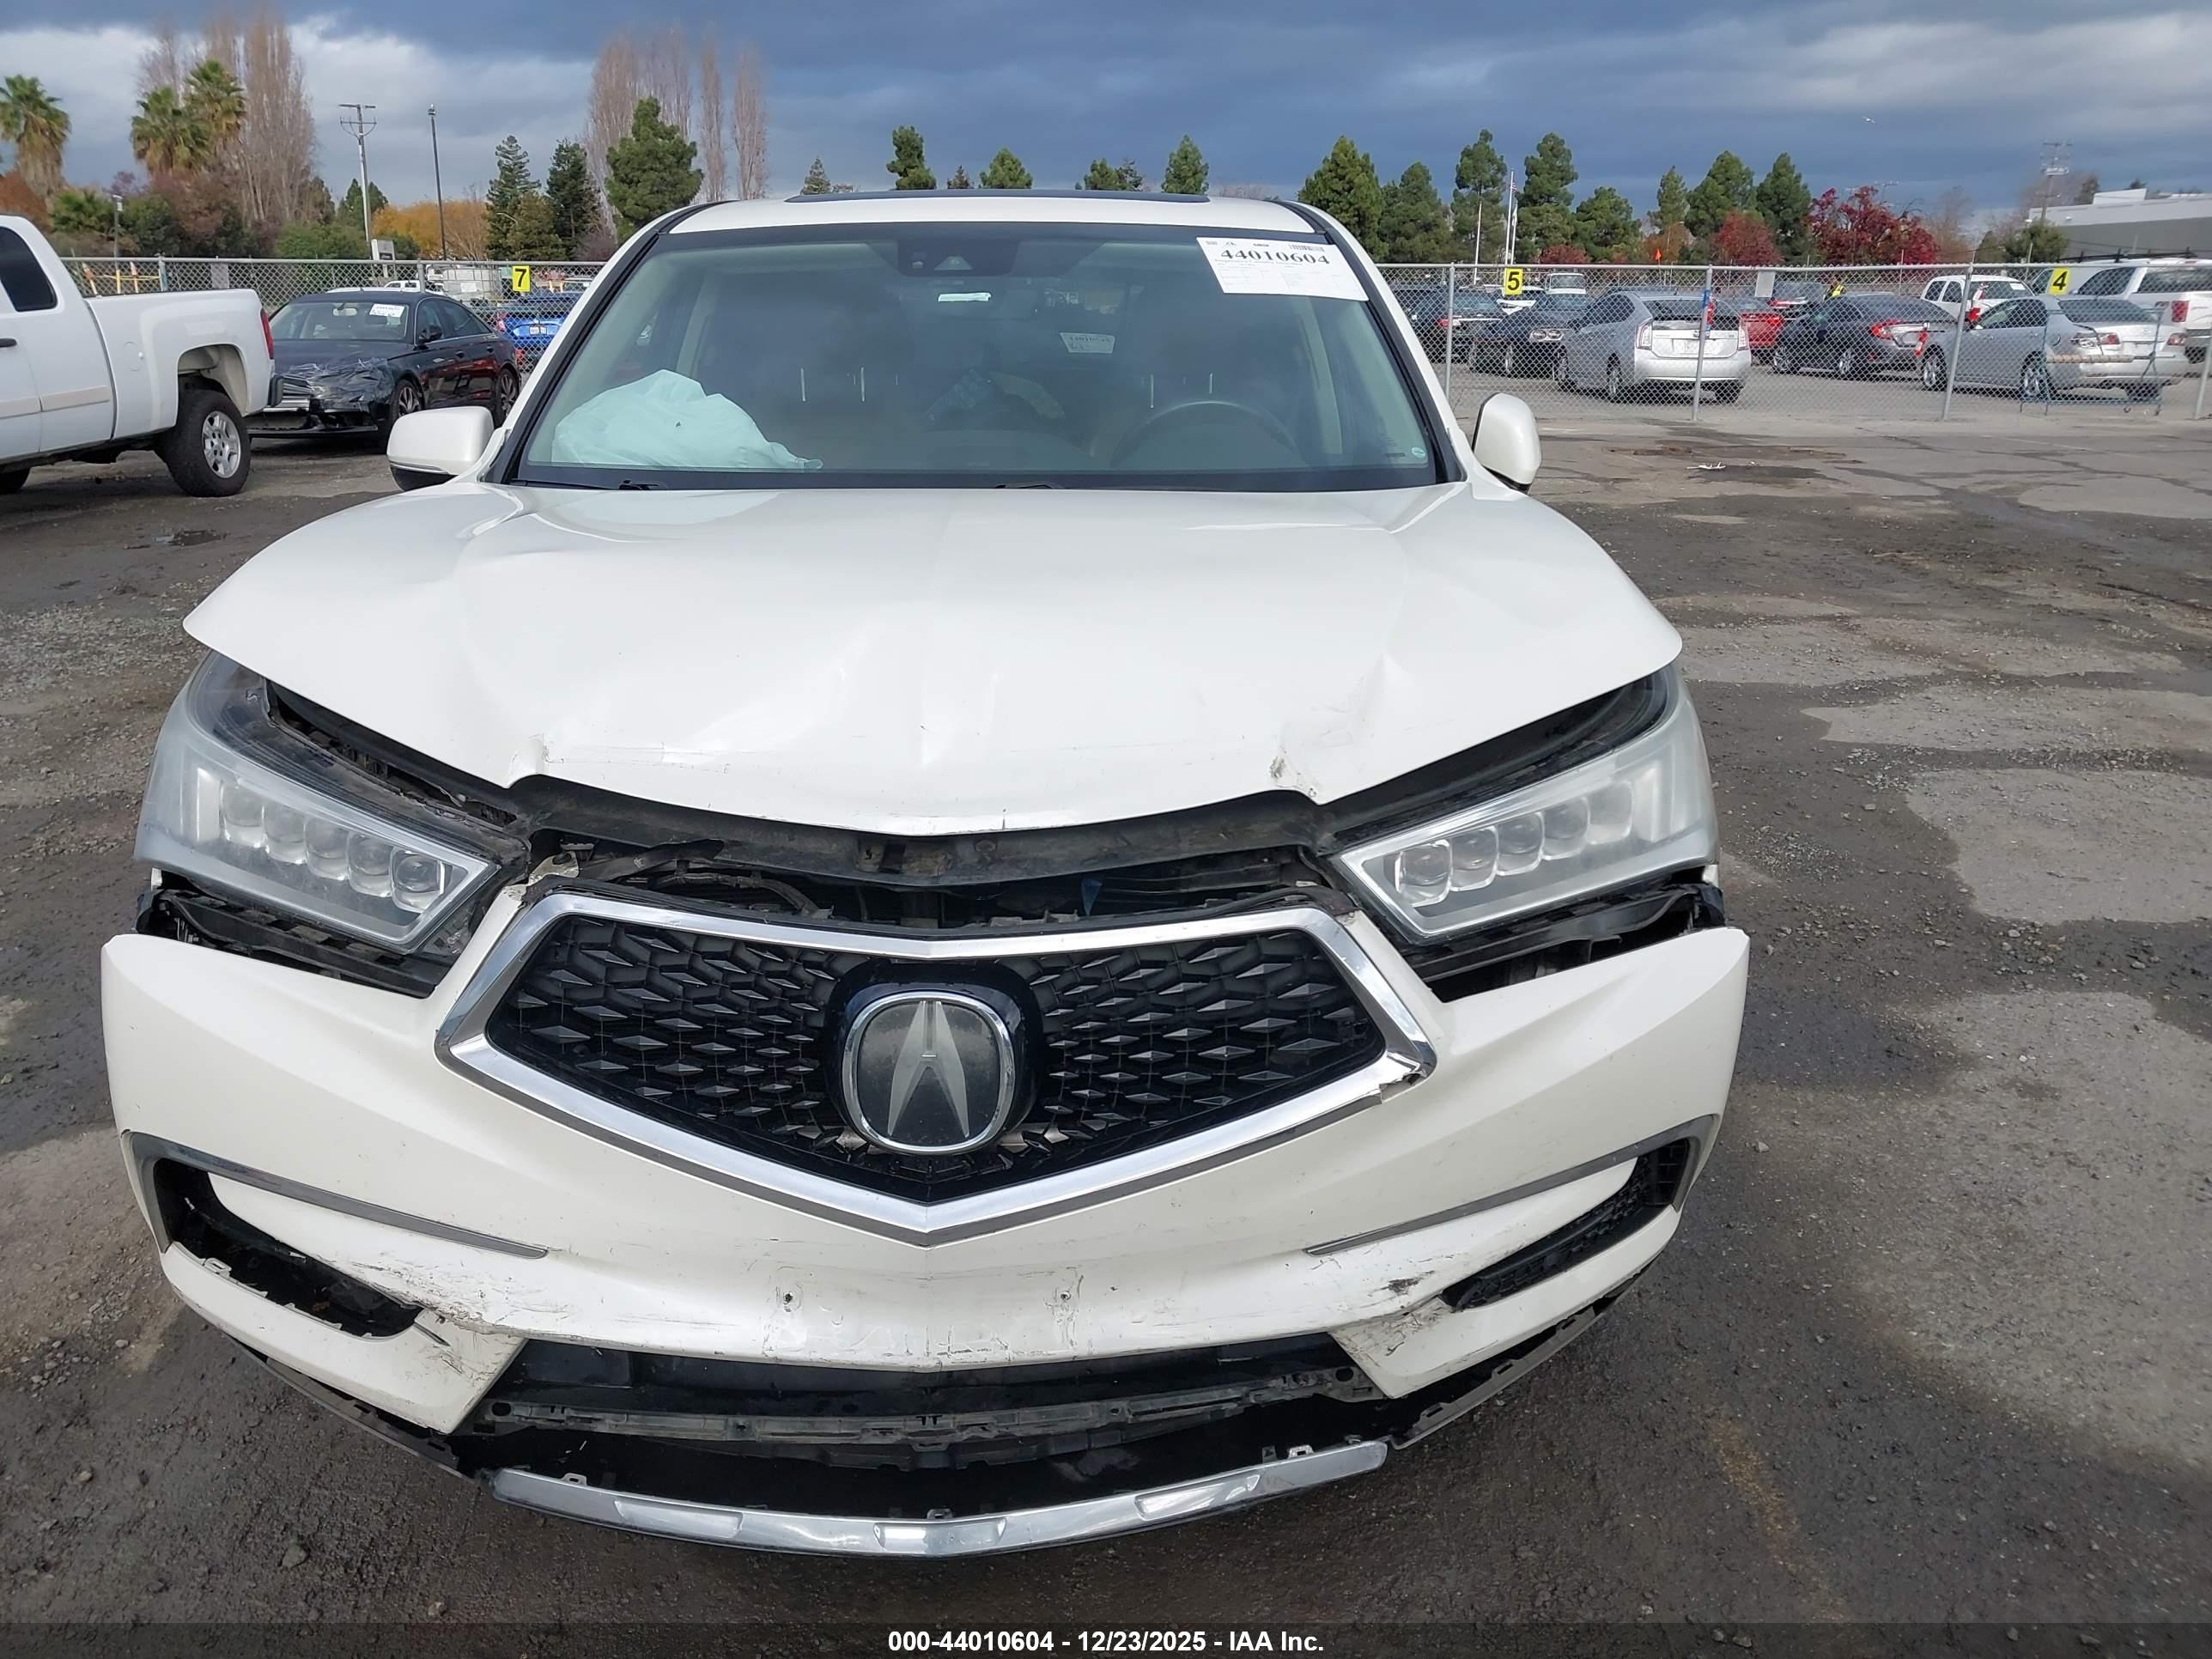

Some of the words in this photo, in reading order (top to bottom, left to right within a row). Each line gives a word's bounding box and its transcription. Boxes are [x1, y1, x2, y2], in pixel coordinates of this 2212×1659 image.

[1221, 249, 1330, 264] 44010604
[515, 269, 527, 288] 7
[1508, 271, 1520, 290] 5
[2052, 270, 2068, 290] 4
